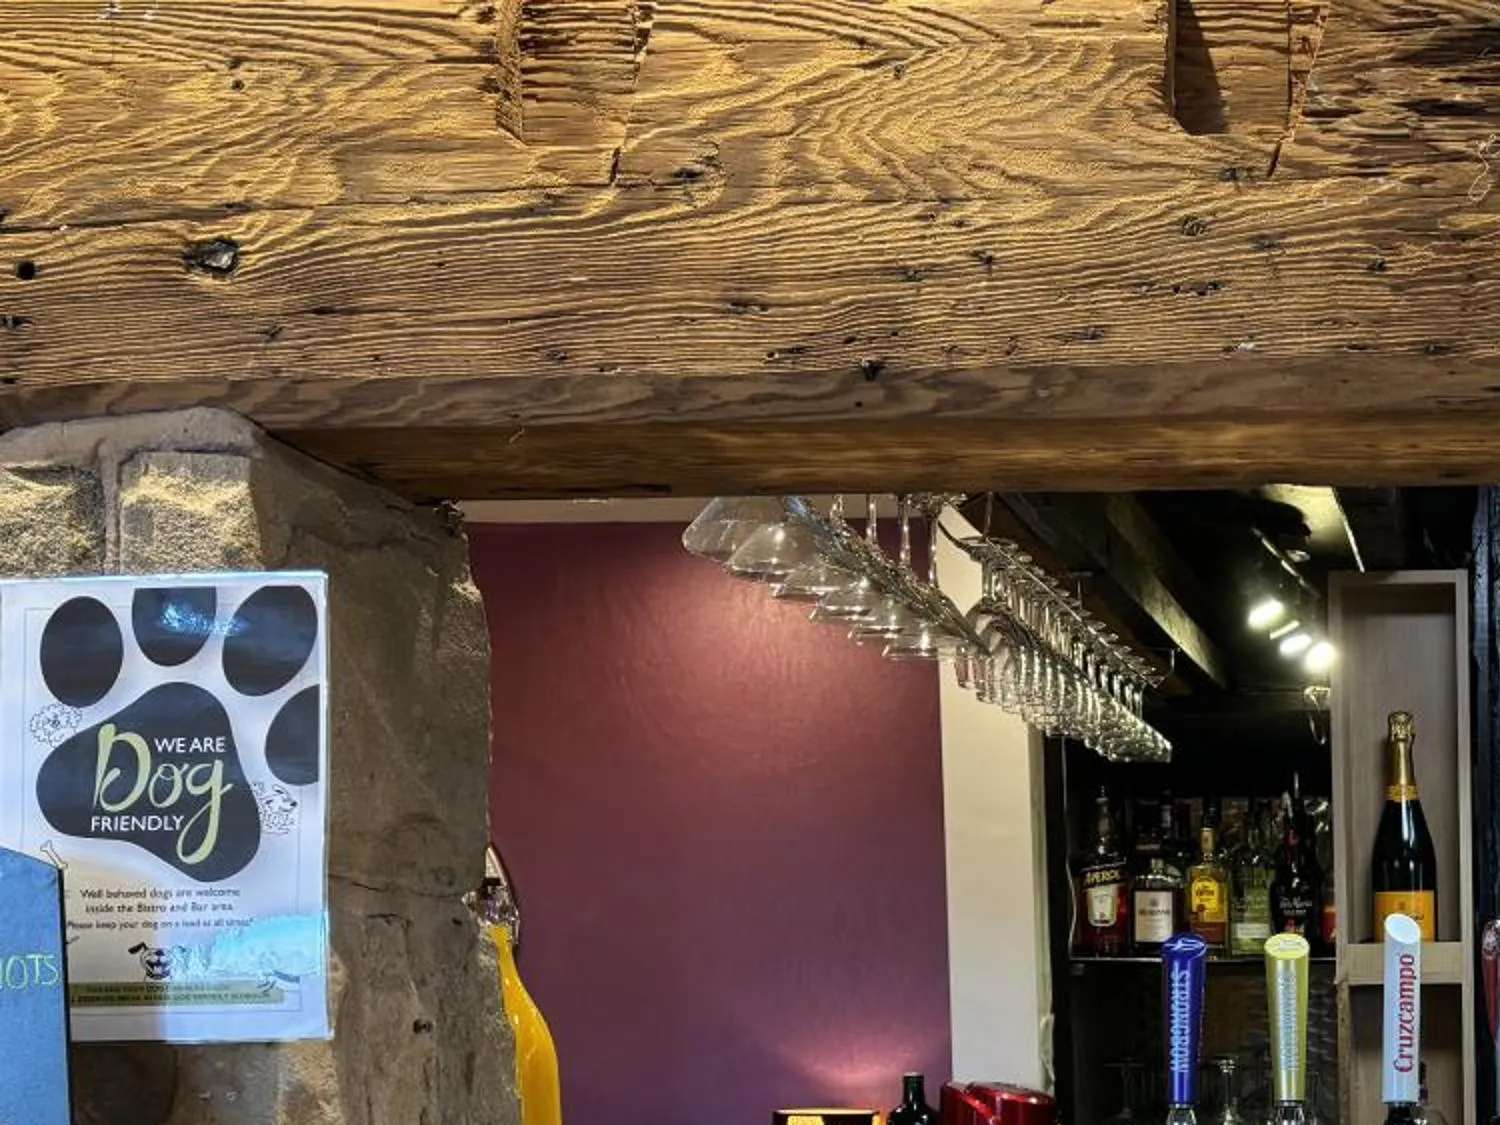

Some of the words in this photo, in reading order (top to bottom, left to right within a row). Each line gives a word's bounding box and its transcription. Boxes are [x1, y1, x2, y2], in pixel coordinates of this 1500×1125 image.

[153, 737, 186, 753] WE
[189, 736, 226, 753] ARE
[93, 723, 235, 865] Dog
[90, 815, 186, 832] FRIENDLY
[117, 902, 134, 913] the
[96, 920, 117, 930] keep
[119, 922, 138, 931] your
[142, 920, 158, 930] dog
[0, 953, 59, 990] OTS
[1168, 968, 1191, 1074] STRONGBOW
[1392, 953, 1416, 1074] Cruzcampo
